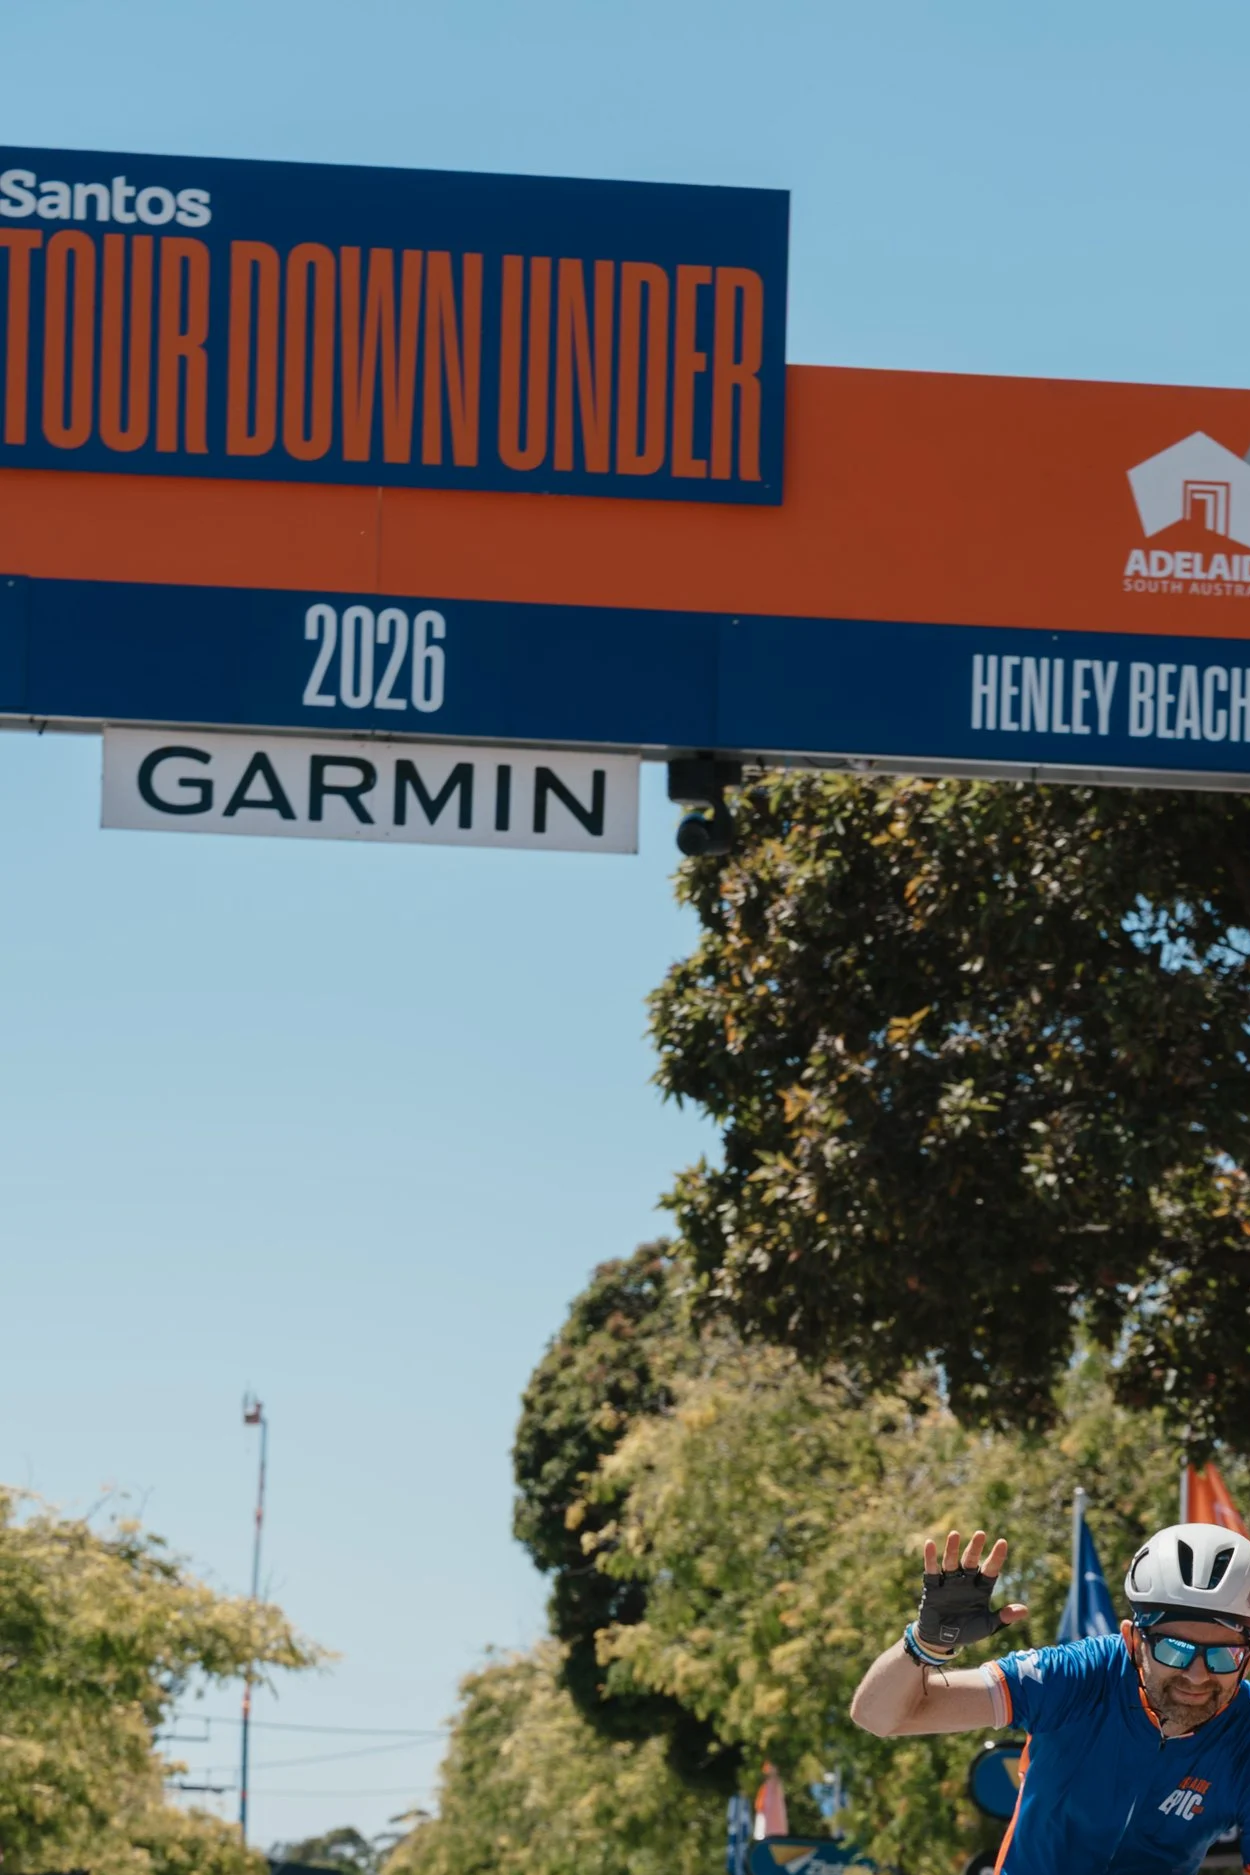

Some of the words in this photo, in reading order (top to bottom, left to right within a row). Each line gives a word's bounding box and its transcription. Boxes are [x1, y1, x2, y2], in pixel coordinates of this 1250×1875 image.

[0, 169, 212, 227] Santos
[0, 228, 211, 455] TOUR
[226, 239, 483, 469] DOWN
[497, 254, 764, 482] UNDER
[1123, 578, 1185, 596] SOUTH
[302, 603, 446, 714] 2026
[971, 654, 1119, 737] HENLEY
[136, 746, 608, 837] GARMIN
[1157, 1788, 1204, 1821] EPIC
